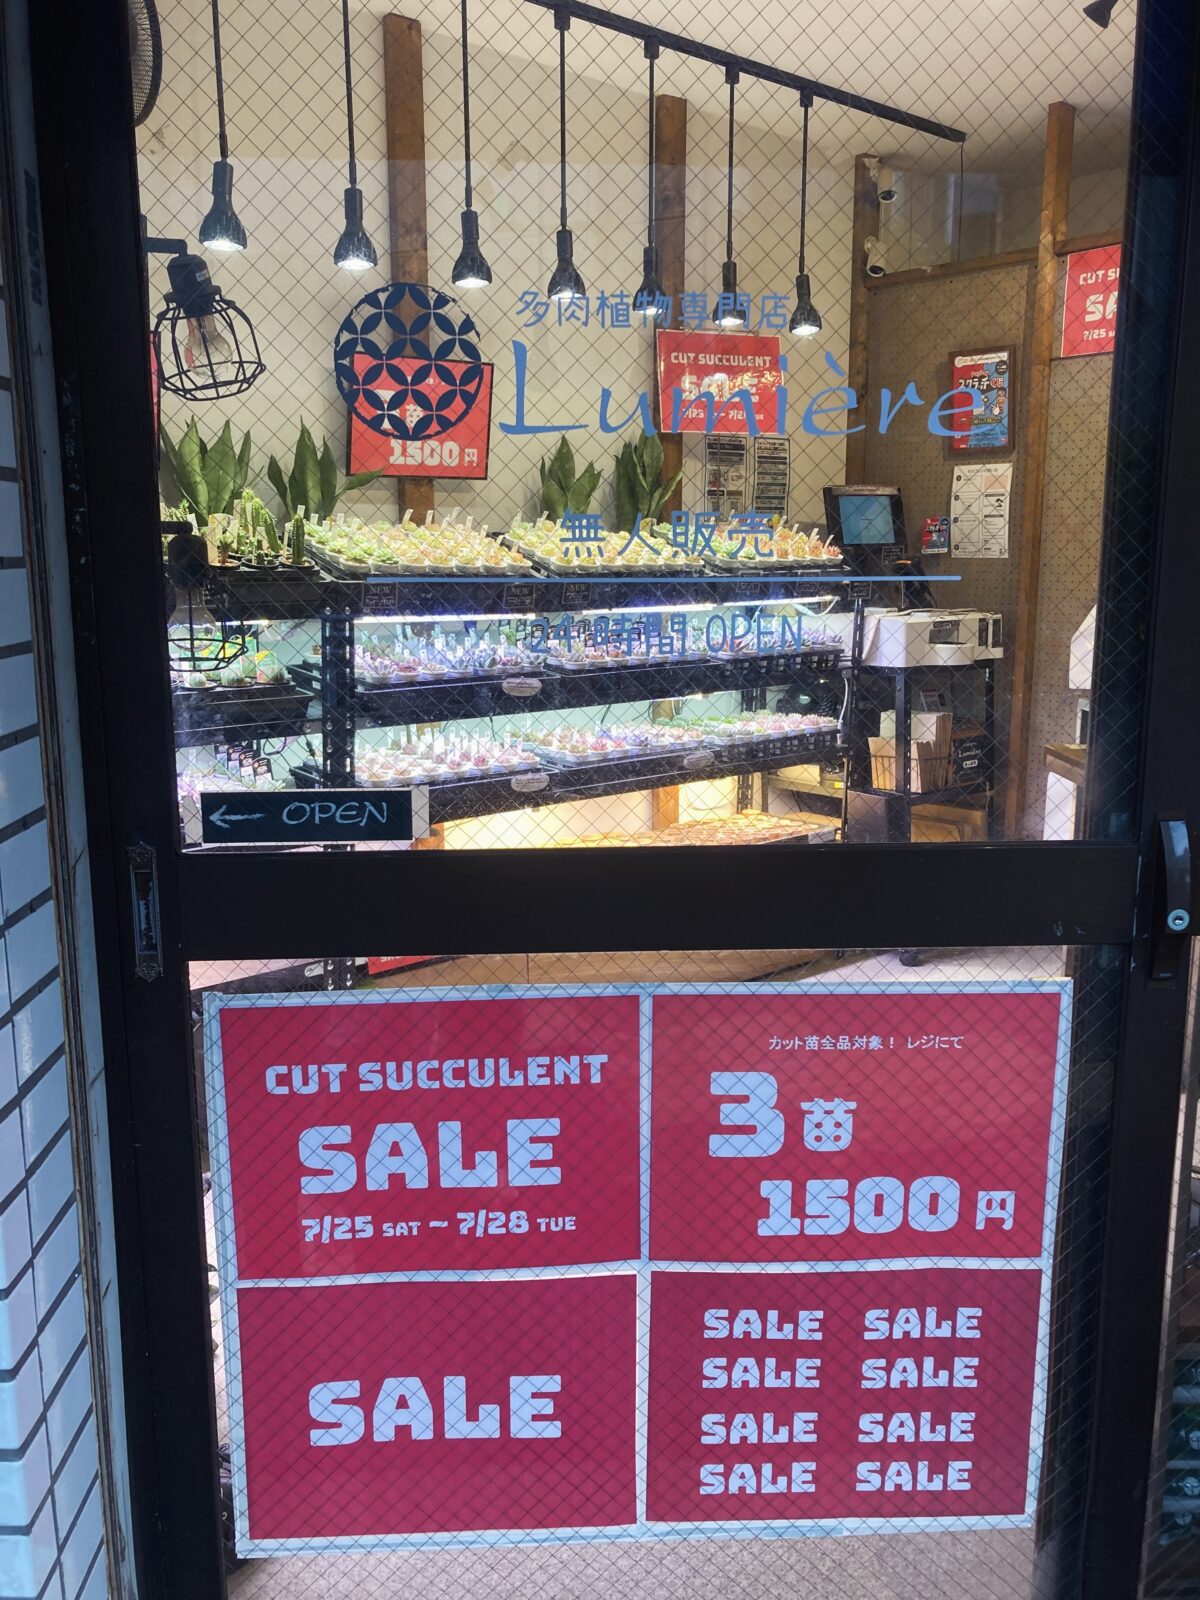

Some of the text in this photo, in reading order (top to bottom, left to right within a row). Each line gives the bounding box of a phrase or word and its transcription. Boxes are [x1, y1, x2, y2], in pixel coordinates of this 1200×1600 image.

[1079, 269, 1105, 286] CUT
[515, 289, 791, 329] 多肉植物専門店
[1083, 328, 1106, 341] 7/25
[670, 352, 772, 368] CUT SUCCULENT
[498, 339, 993, 438] Lumière
[728, 409, 750, 420] 7/2
[559, 507, 774, 559] 無人販売
[529, 612, 804, 657] 24時間 OPEN
[281, 801, 388, 827] OPEN
[907, 1034, 965, 1049] レジにて
[265, 1054, 609, 1095] CUT SUCCULENT
[299, 1117, 562, 1195] SALE
[301, 1215, 374, 1244] 7/25
[382, 1221, 421, 1237] SAT
[456, 1209, 530, 1238] 7/28
[536, 1215, 577, 1232] TUE
[703, 1306, 983, 1341] SALE SALE
[702, 1356, 980, 1389] SALE SALE
[308, 1374, 562, 1447] SALE
[700, 1411, 976, 1445] SALE SALE
[699, 1460, 973, 1495] SALE SALE
